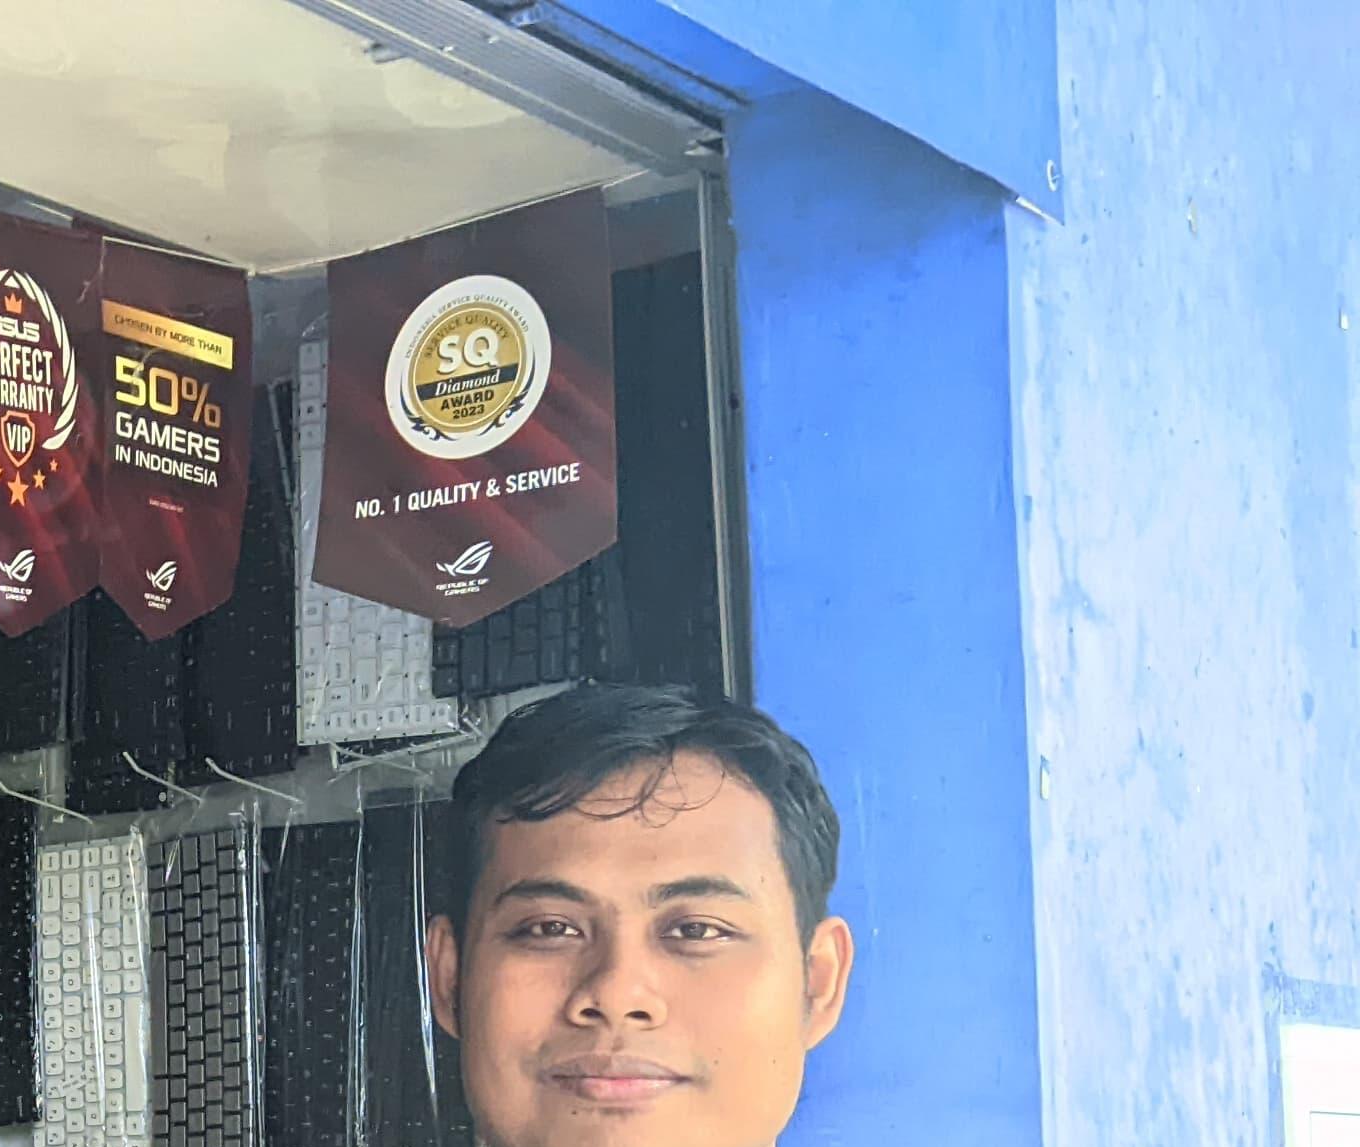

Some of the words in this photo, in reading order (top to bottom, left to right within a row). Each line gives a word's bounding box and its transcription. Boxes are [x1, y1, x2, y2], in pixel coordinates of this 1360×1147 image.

[114, 314, 152, 335] CHOSEN
[155, 324, 168, 338] BY
[170, 329, 196, 348] MORE
[199, 340, 222, 356] THAN
[437, 327, 499, 375] SQ
[115, 355, 221, 428] 50%
[435, 369, 500, 397] Diamond
[441, 389, 494, 411] AWARD
[452, 404, 485, 420] 2023
[6, 422, 31, 453] VIP
[116, 411, 220, 463] GAMERS
[115, 444, 131, 464] IN
[135, 450, 217, 488] INDONESIA
[355, 498, 385, 519] NO.
[393, 496, 400, 514] 1
[408, 481, 482, 512] QUALITY
[486, 479, 501, 498] &
[506, 462, 582, 492] SERVICE
